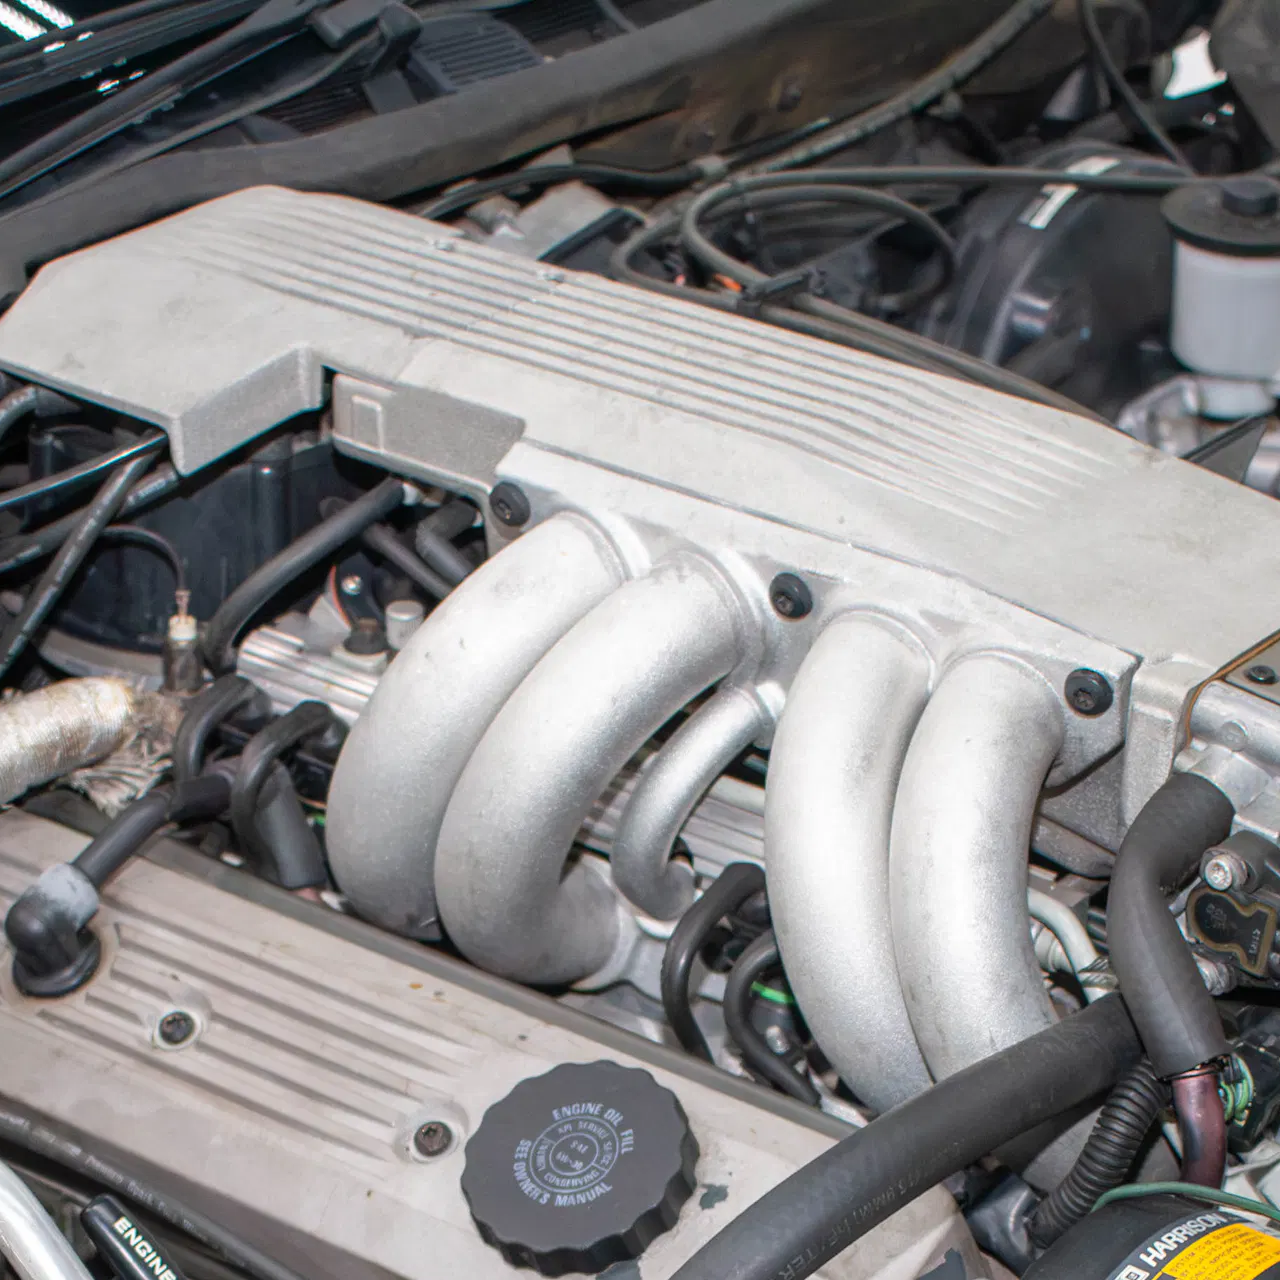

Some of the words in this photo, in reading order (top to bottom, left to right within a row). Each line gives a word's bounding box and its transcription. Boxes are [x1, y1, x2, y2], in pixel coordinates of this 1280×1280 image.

[514, 1138, 532, 1159] SEE
[552, 1102, 605, 1121] ENGINE
[603, 1108, 624, 1127] OIL
[620, 1128, 634, 1155] FILL
[513, 1161, 551, 1205] OWNER'S
[554, 1182, 613, 1207] MANUAL
[1139, 1212, 1228, 1268] HARRISON
